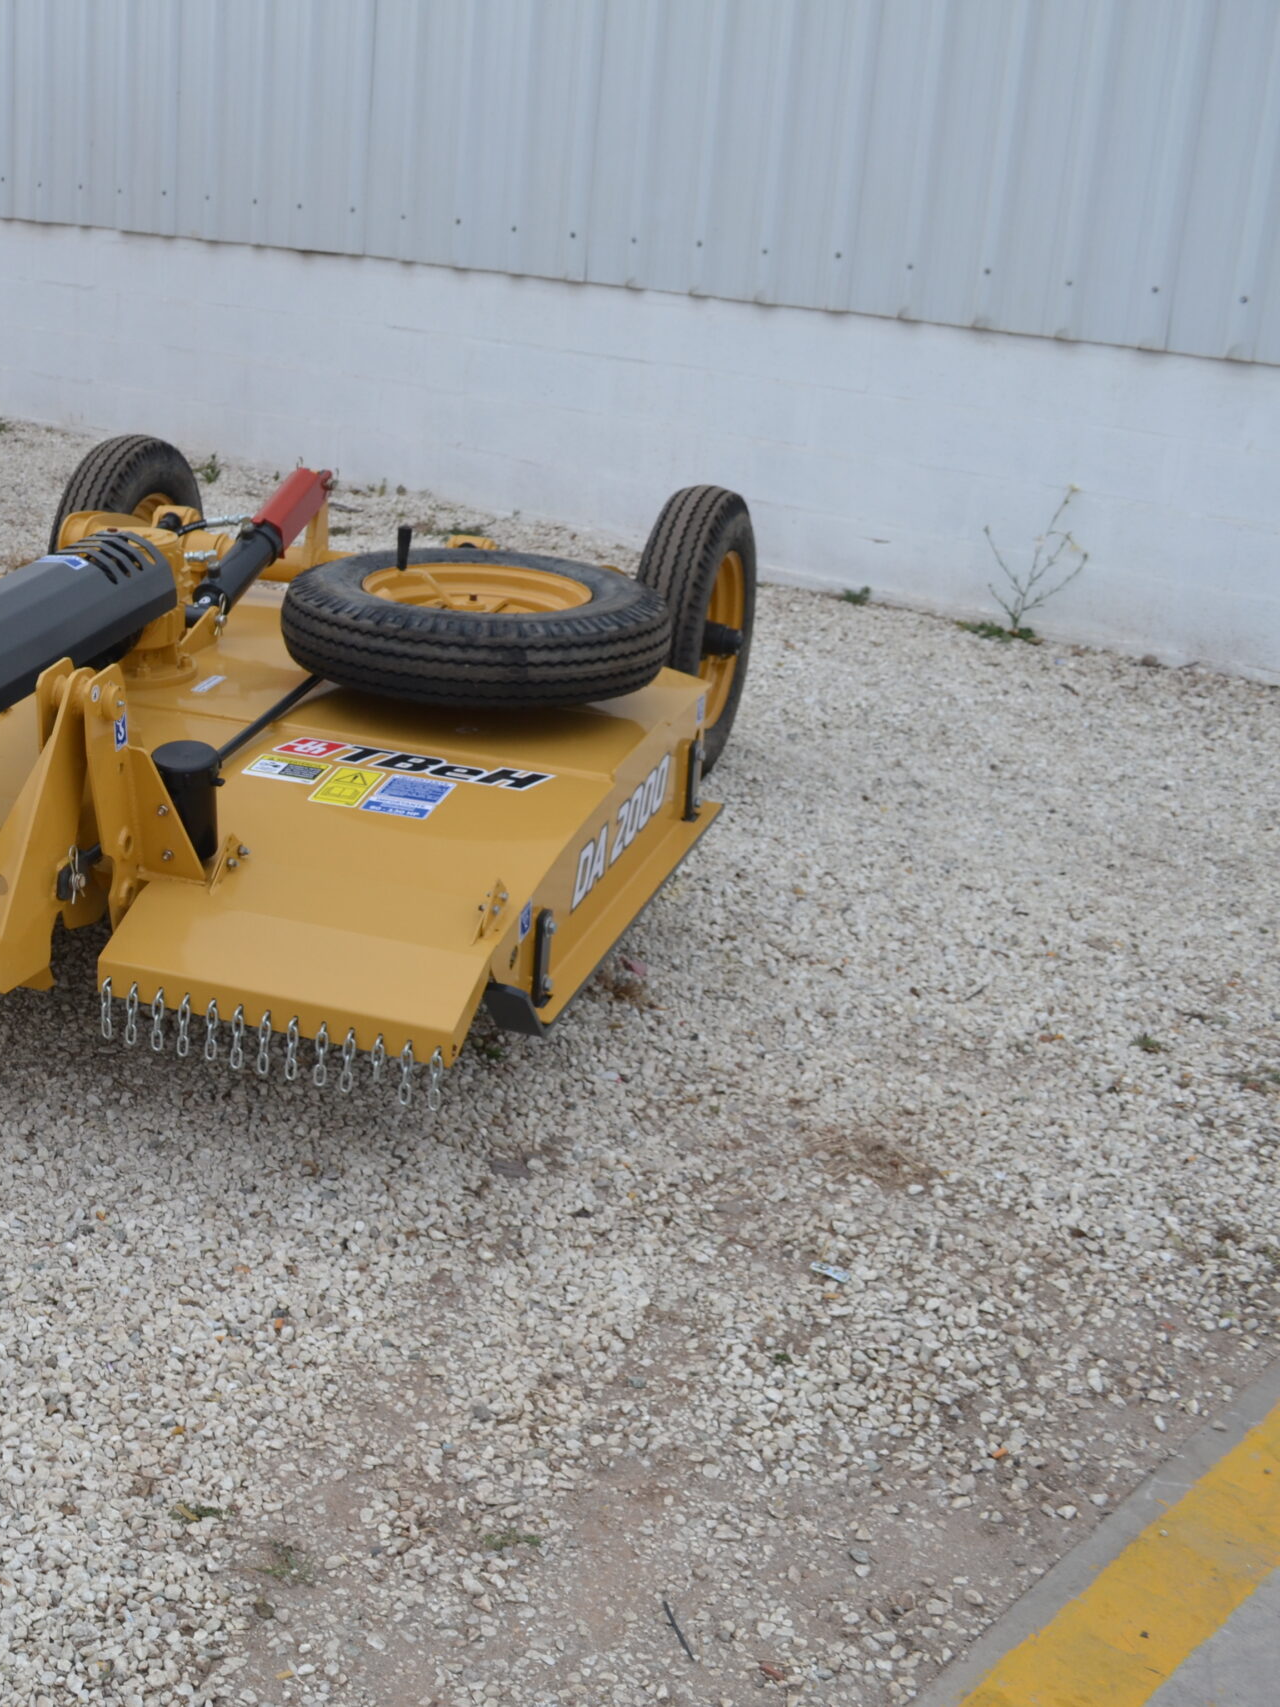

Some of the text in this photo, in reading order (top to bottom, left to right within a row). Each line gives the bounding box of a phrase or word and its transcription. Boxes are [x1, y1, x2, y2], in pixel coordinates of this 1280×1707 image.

[333, 744, 556, 791] TBeH
[570, 752, 670, 915] DA 2000
